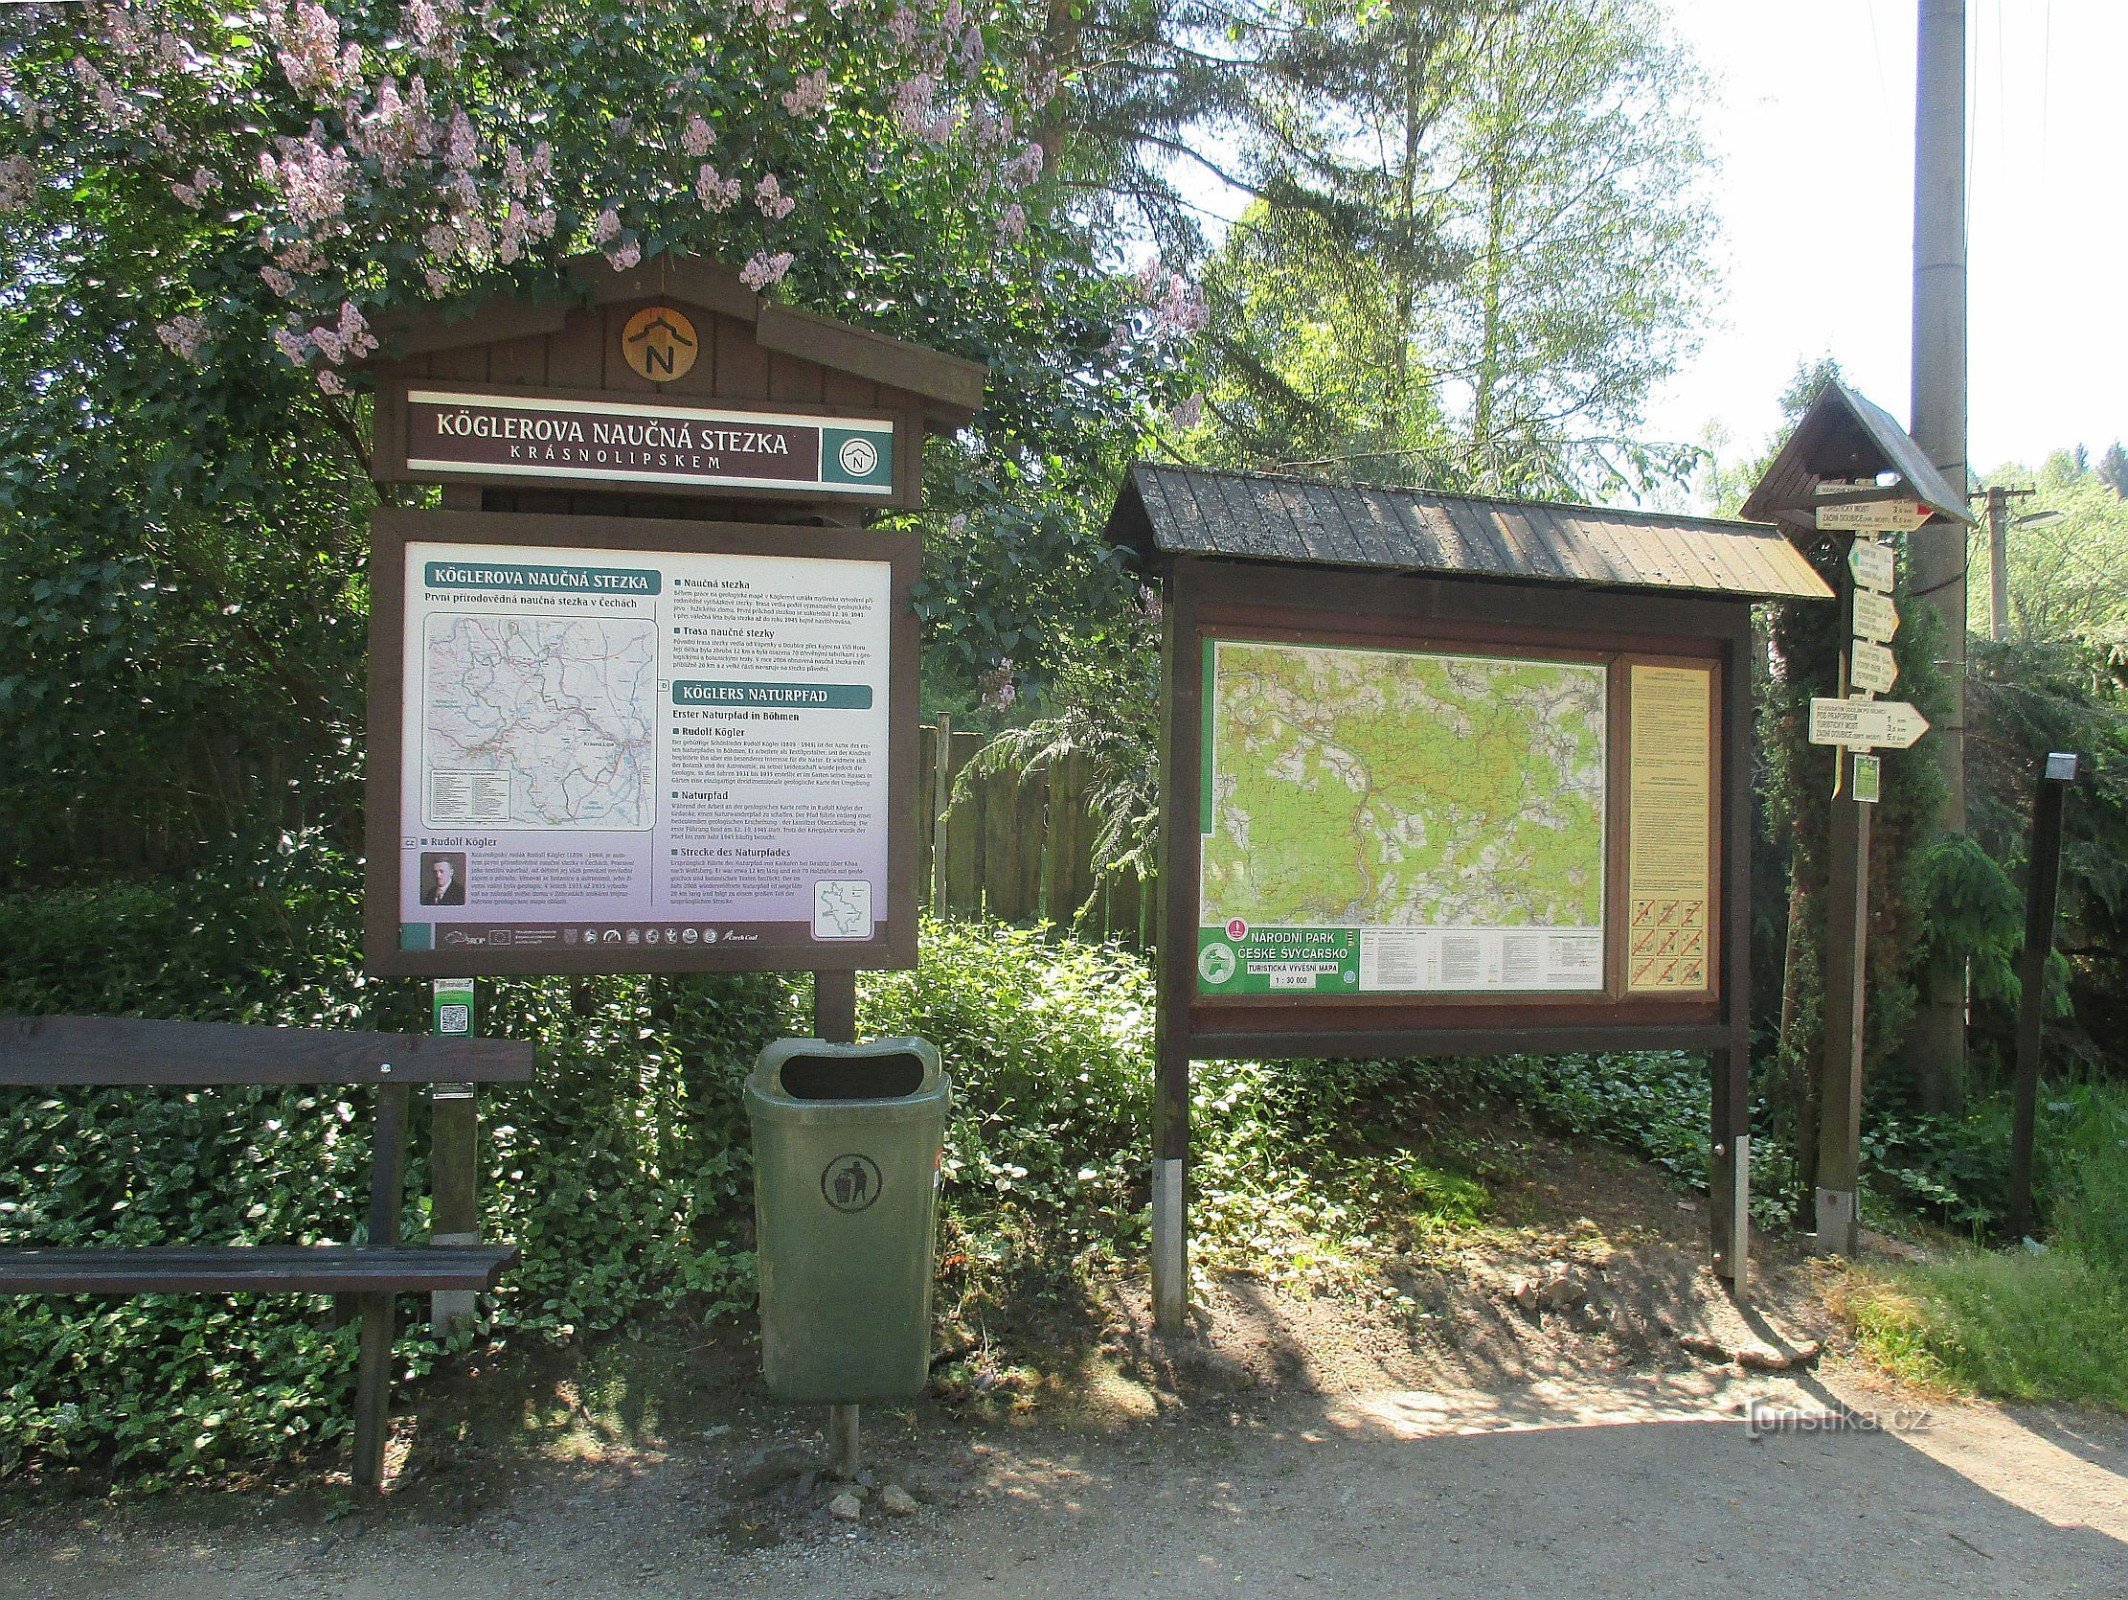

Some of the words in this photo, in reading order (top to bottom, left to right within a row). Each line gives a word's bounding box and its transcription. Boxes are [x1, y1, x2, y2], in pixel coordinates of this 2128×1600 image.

[436, 409, 585, 444] KÖGLEROVA
[593, 420, 693, 449] NAUČNÁ
[700, 429, 789, 455] STEZKA
[510, 443, 721, 470] KRÁSNOLIPSKEM
[434, 566, 523, 585] KÖGLEROVA
[528, 570, 589, 587] NAUČNÁ
[593, 574, 649, 589] STEZKA
[684, 578, 719, 589] Naučná
[721, 580, 750, 590] stezka
[424, 592, 451, 602] První
[453, 593, 518, 606] přírodovědná
[520, 595, 556, 605] naučná
[558, 597, 588, 607] stezka
[599, 597, 638, 608] Čechách
[683, 626, 708, 636] Trasa
[710, 627, 744, 637] naučné
[746, 628, 775, 639] stezky
[683, 684, 744, 700] KÖGLERS
[749, 688, 828, 703] NATURPFAD
[672, 709, 700, 719] Erster
[701, 710, 749, 721] Naturpfad
[751, 711, 760, 720] in
[763, 711, 800, 721] Böhmen
[682, 727, 713, 737] Rudolf
[715, 728, 745, 738] Kögler
[681, 791, 729, 802] Naturpfad
[430, 837, 463, 847] Rudolf
[465, 837, 497, 848] Kögler
[680, 847, 715, 857] Strecke
[717, 848, 733, 857] des
[735, 848, 791, 859] Naturpfades
[1251, 930, 1303, 943] NÁRODNÍ
[1305, 933, 1335, 944] PARK
[1238, 945, 1276, 960] ČESKÉ
[1280, 946, 1348, 960] ŠVÝCARSKO
[1249, 963, 1287, 973] TURISTICKÁ
[1318, 964, 1337, 973] MAPA
